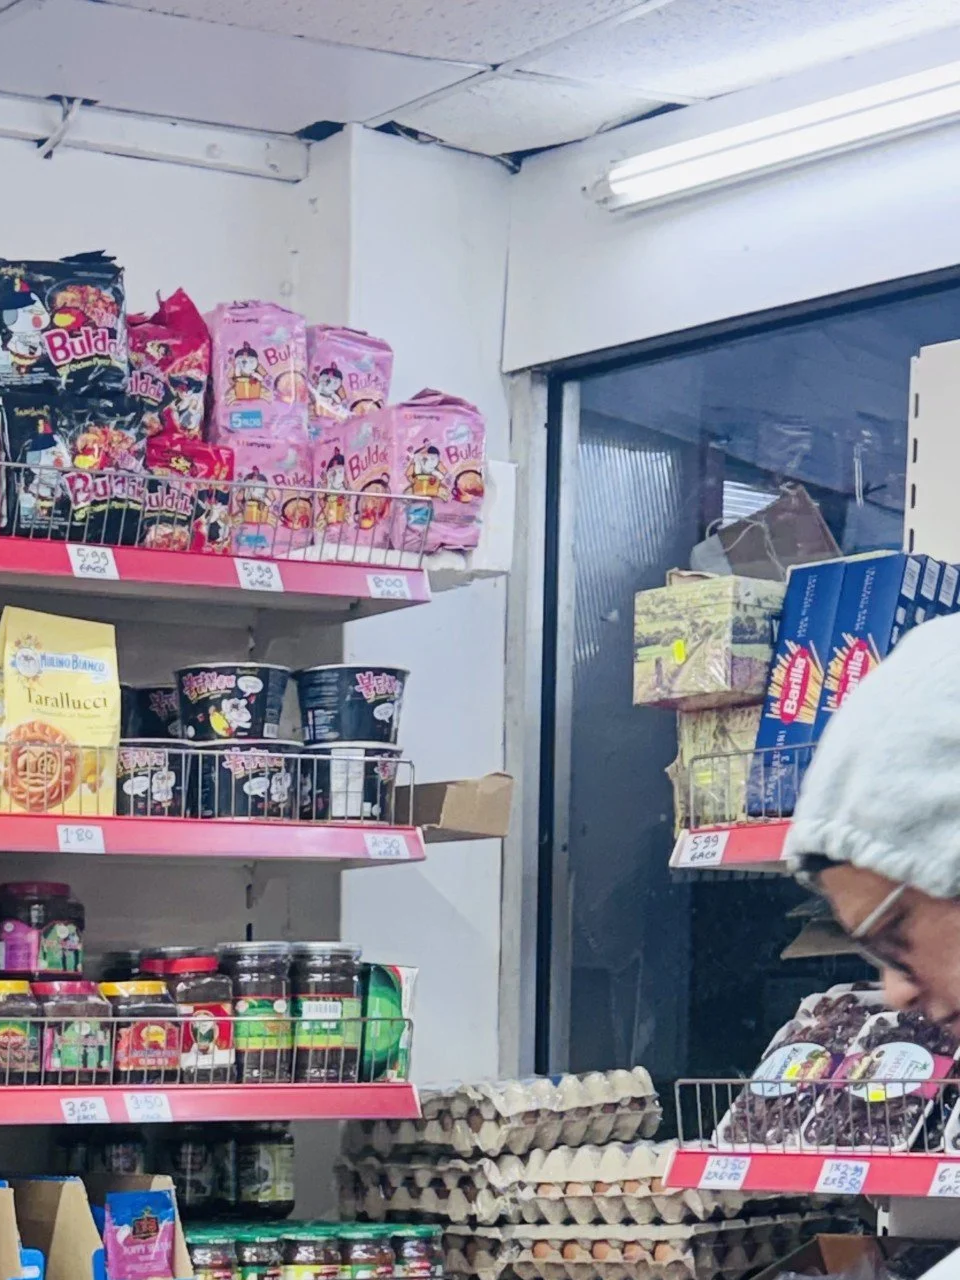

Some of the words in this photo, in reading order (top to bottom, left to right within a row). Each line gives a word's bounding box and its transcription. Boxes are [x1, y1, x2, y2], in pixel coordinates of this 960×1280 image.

[783, 653, 808, 718] Barilla
[25, 687, 108, 711] Tarallucci
[690, 835, 719, 851] 5.99
[938, 1183, 960, 1195] EAC
